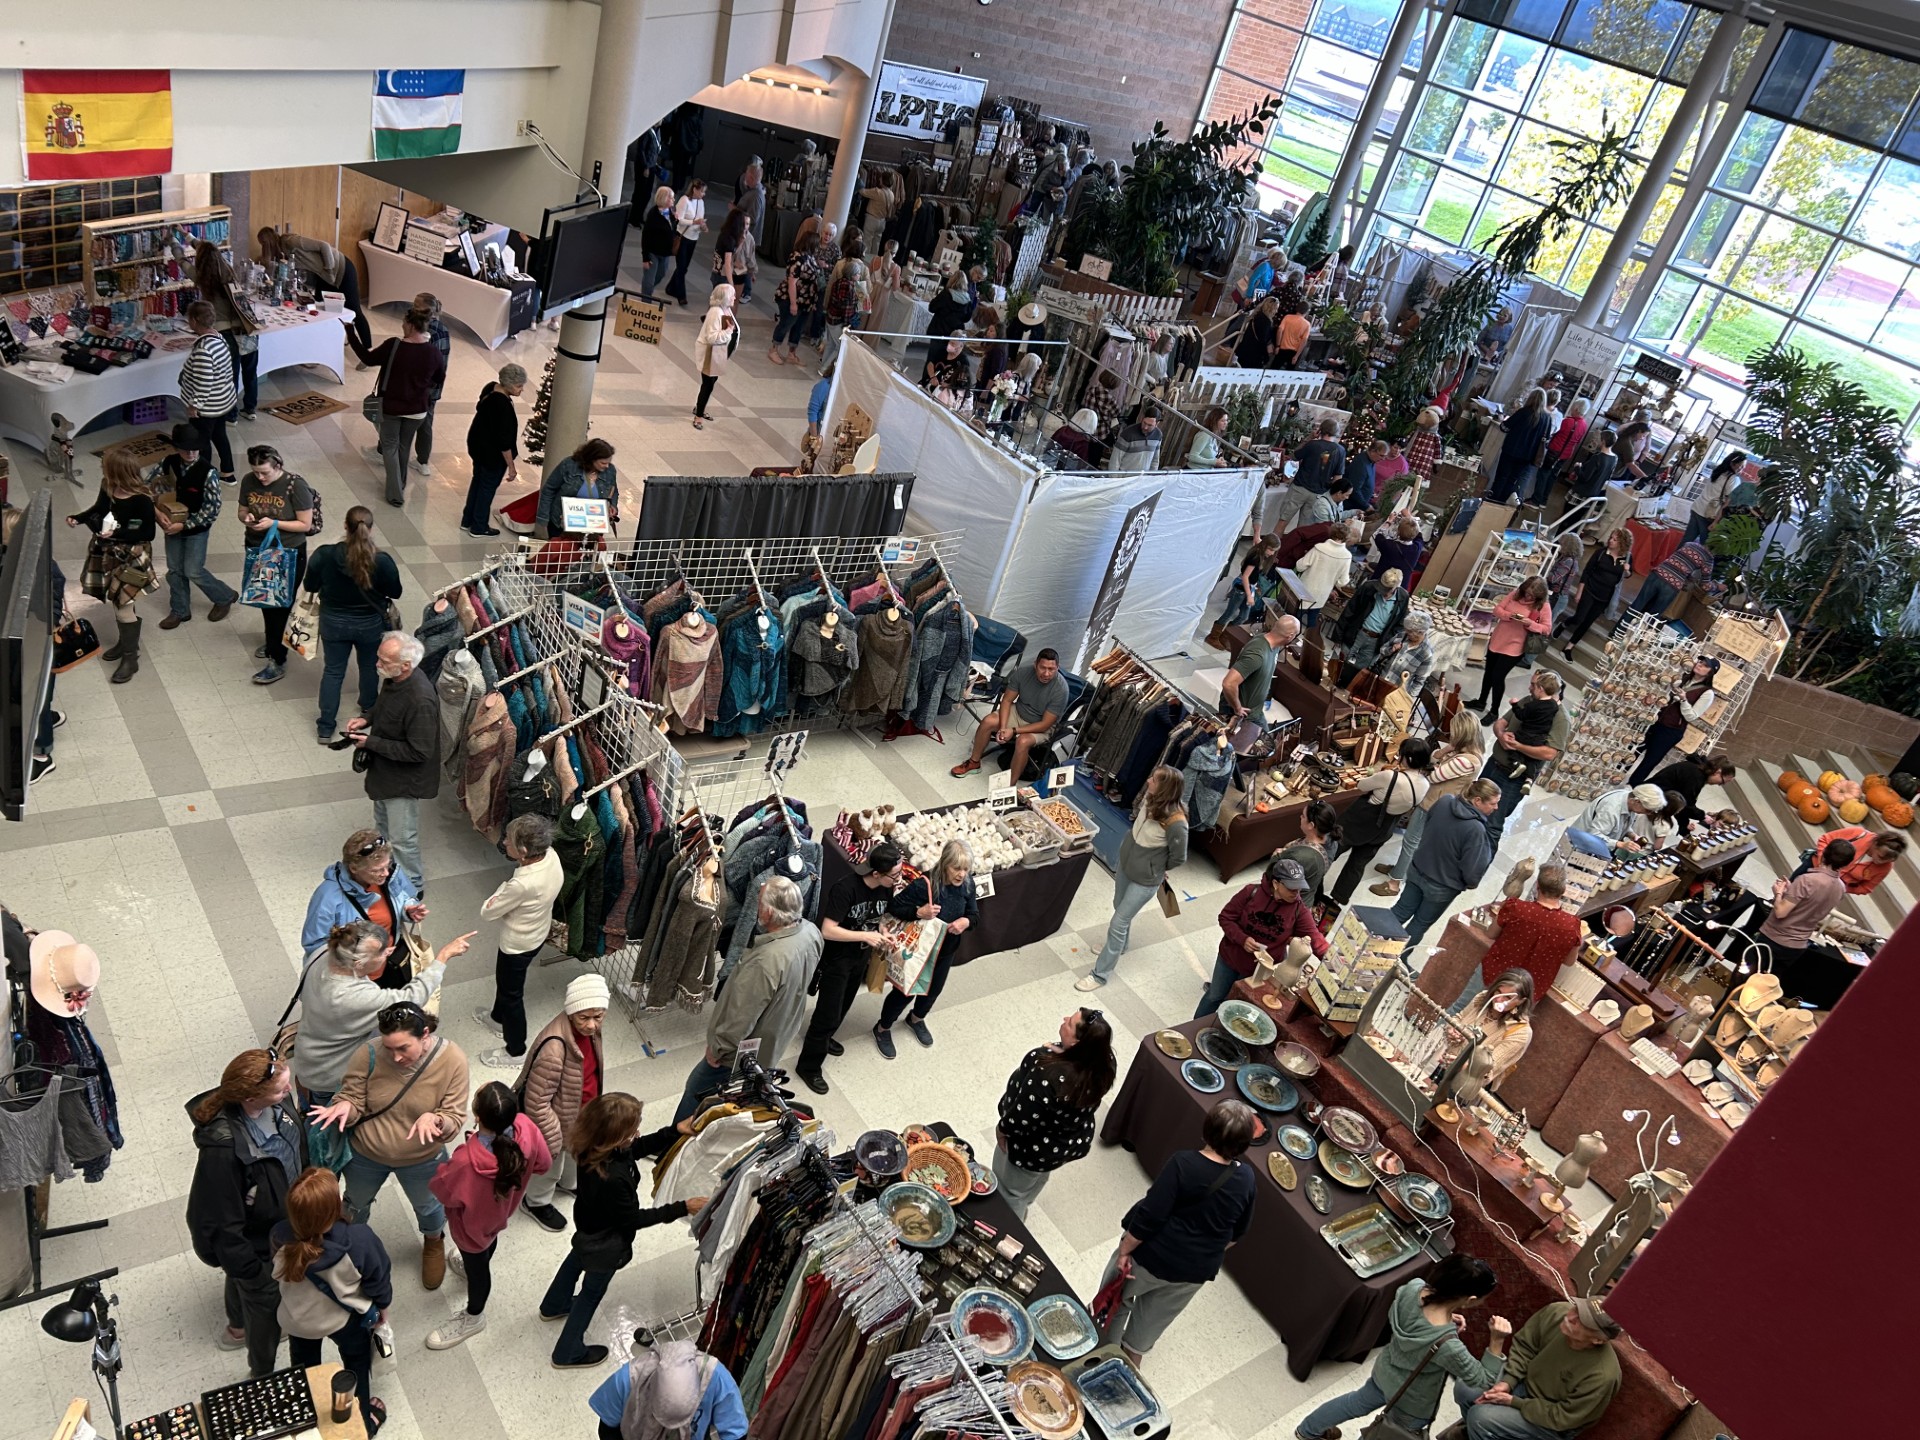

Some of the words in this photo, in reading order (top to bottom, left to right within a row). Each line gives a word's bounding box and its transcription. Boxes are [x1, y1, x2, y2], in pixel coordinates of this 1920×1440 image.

[875, 91, 976, 132] LPHS
[408, 238, 426, 248] MORSE
[428, 242, 443, 252] CODE
[410, 232, 442, 245] HANDMADE
[622, 304, 662, 322] Wander
[633, 318, 660, 332] Haus
[625, 328, 658, 344] Goods
[1567, 330, 1582, 342] Life
[1584, 338, 1593, 347] At
[1594, 340, 1616, 356] Home
[1639, 362, 1674, 380] FOOTBALL
[248, 492, 284, 508] STRUTS
[568, 602, 583, 613] VISA
[1246, 924, 1276, 942] Roots
